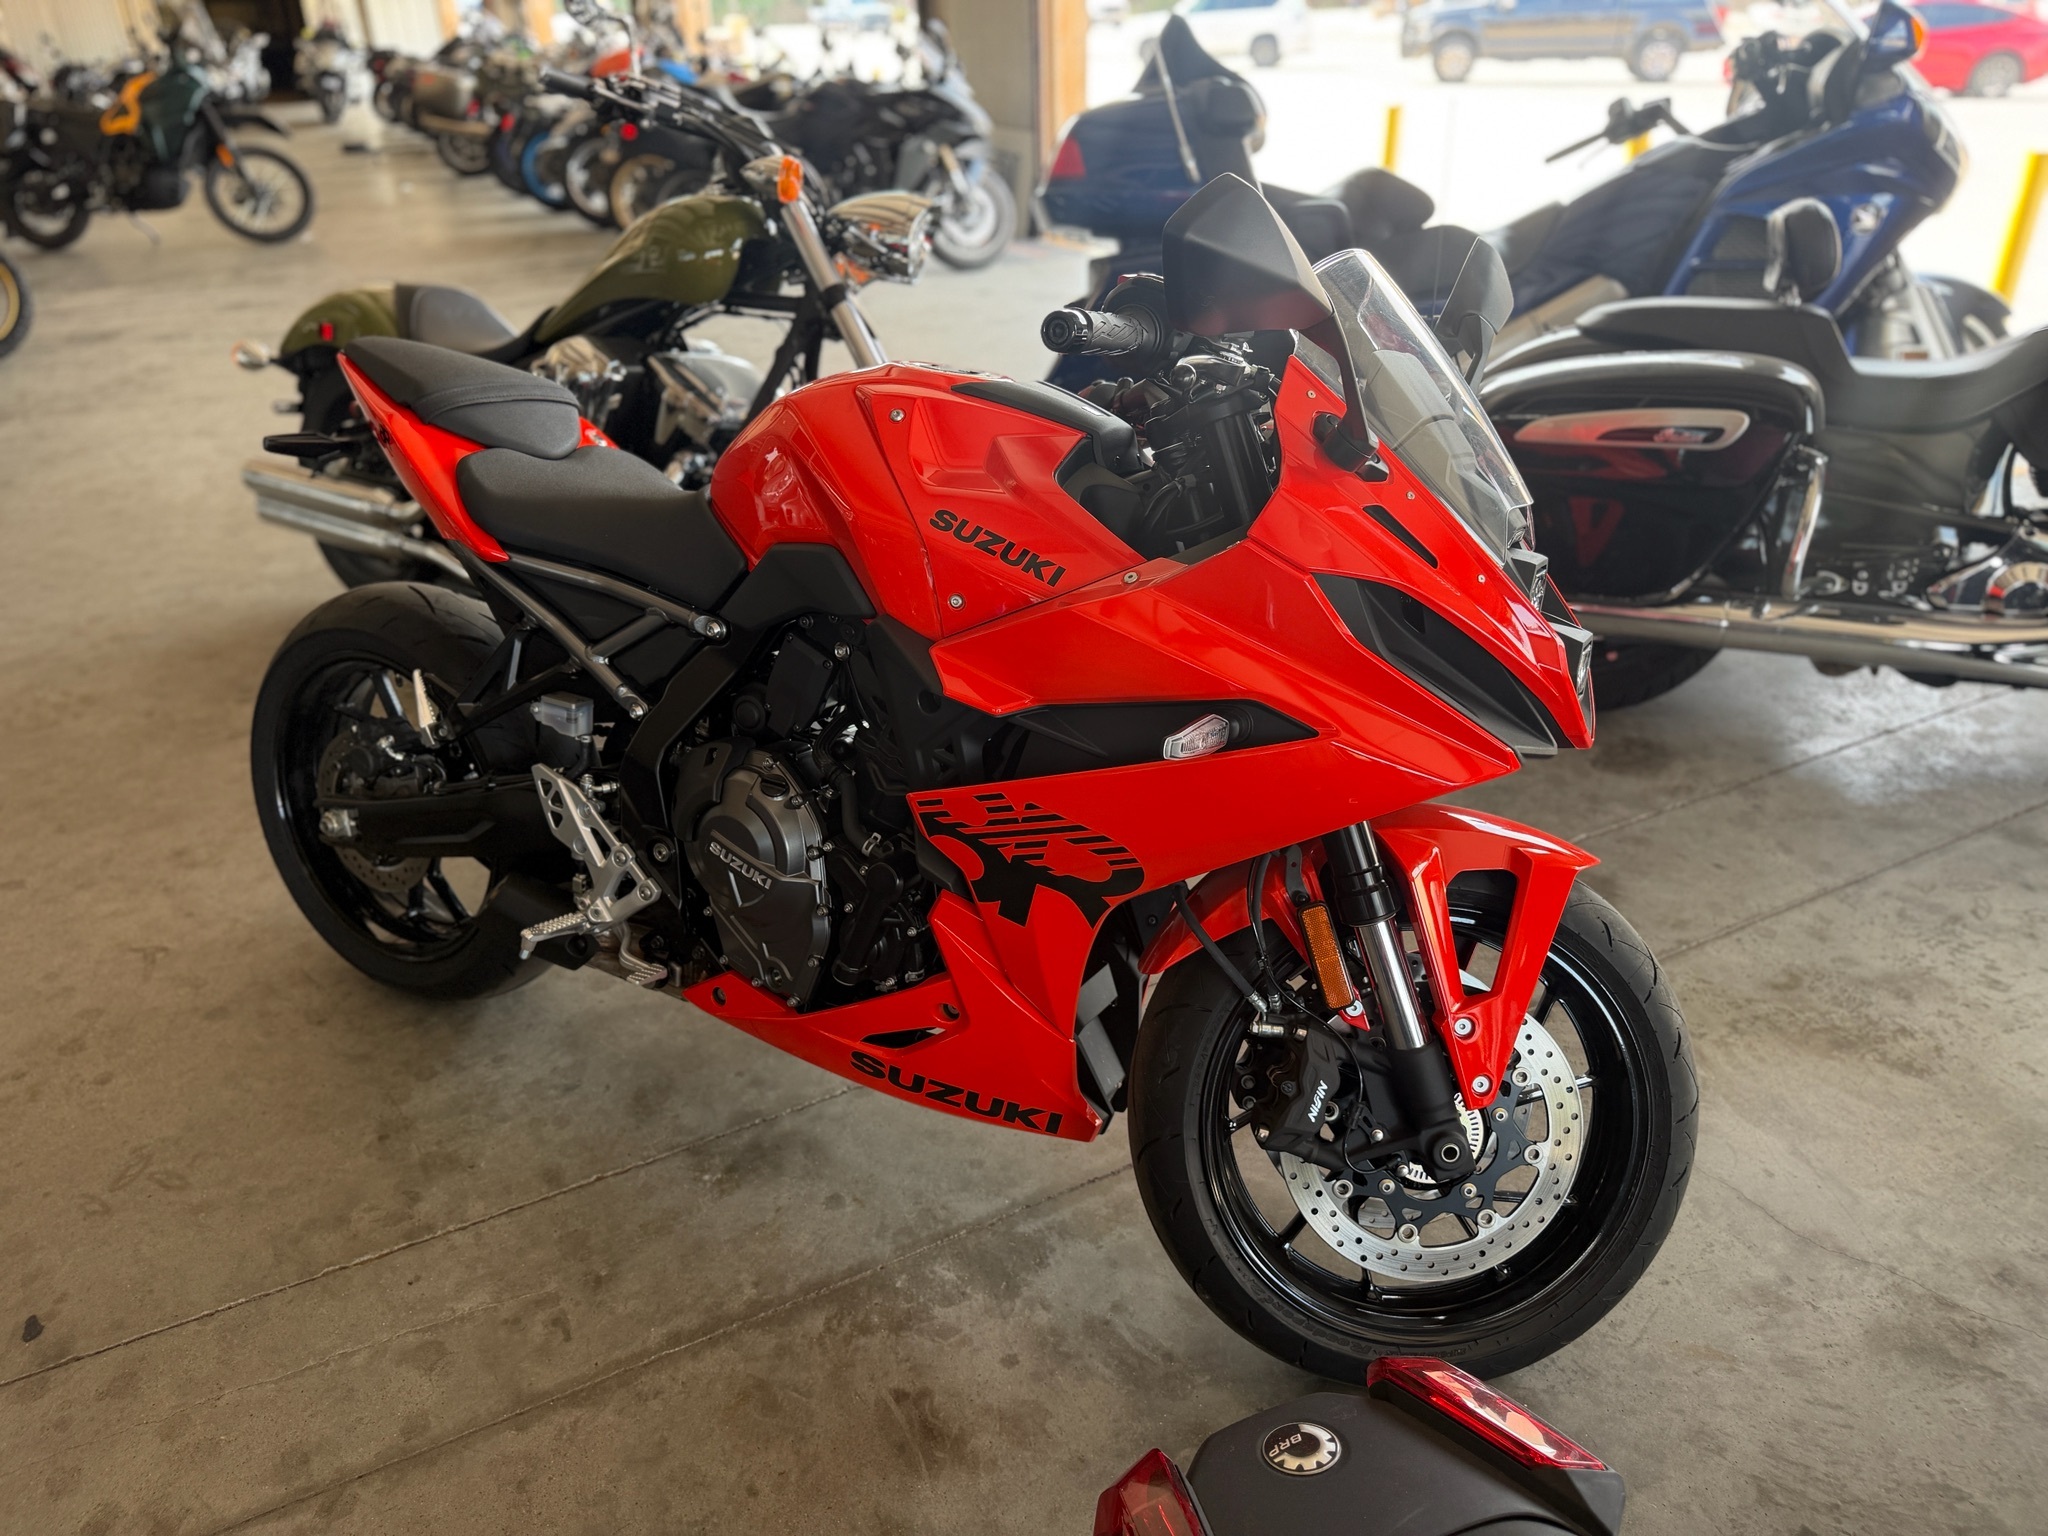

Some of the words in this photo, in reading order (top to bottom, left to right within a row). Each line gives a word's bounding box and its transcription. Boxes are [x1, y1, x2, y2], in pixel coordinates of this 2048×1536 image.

[929, 509, 1067, 588] SUZUKI
[709, 841, 773, 890] SUZUKI
[850, 1050, 1064, 1135] SUZUKI
[1268, 1433, 1302, 1458] BRP
